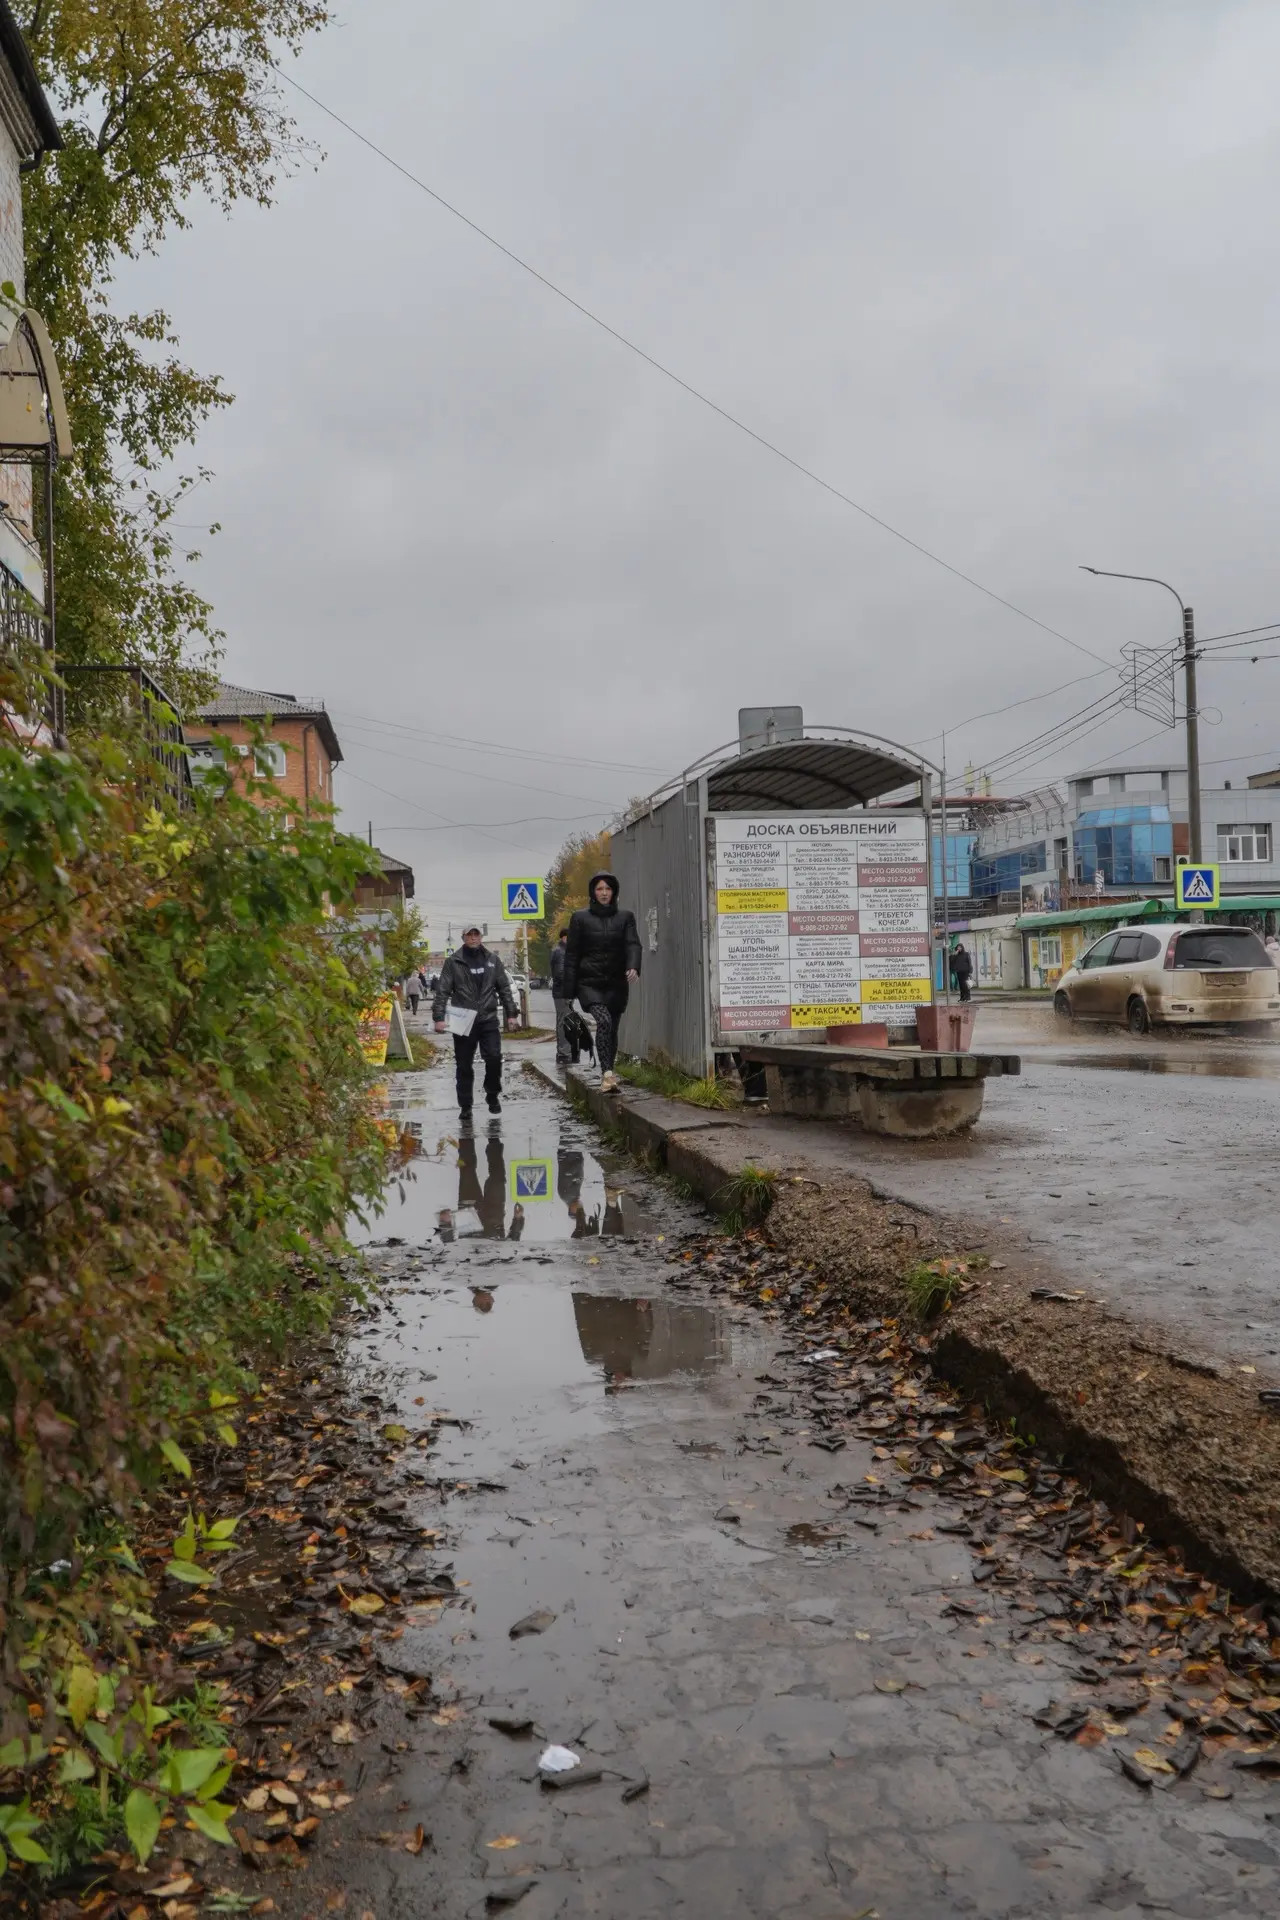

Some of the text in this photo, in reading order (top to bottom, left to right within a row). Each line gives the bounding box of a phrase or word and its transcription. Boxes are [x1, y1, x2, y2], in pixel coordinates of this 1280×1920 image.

[747, 821, 896, 837] ДОСКА ОБЪЯВЛЕНИЙ
[728, 944, 779, 952] ШАШЛЫЧНЫЙ
